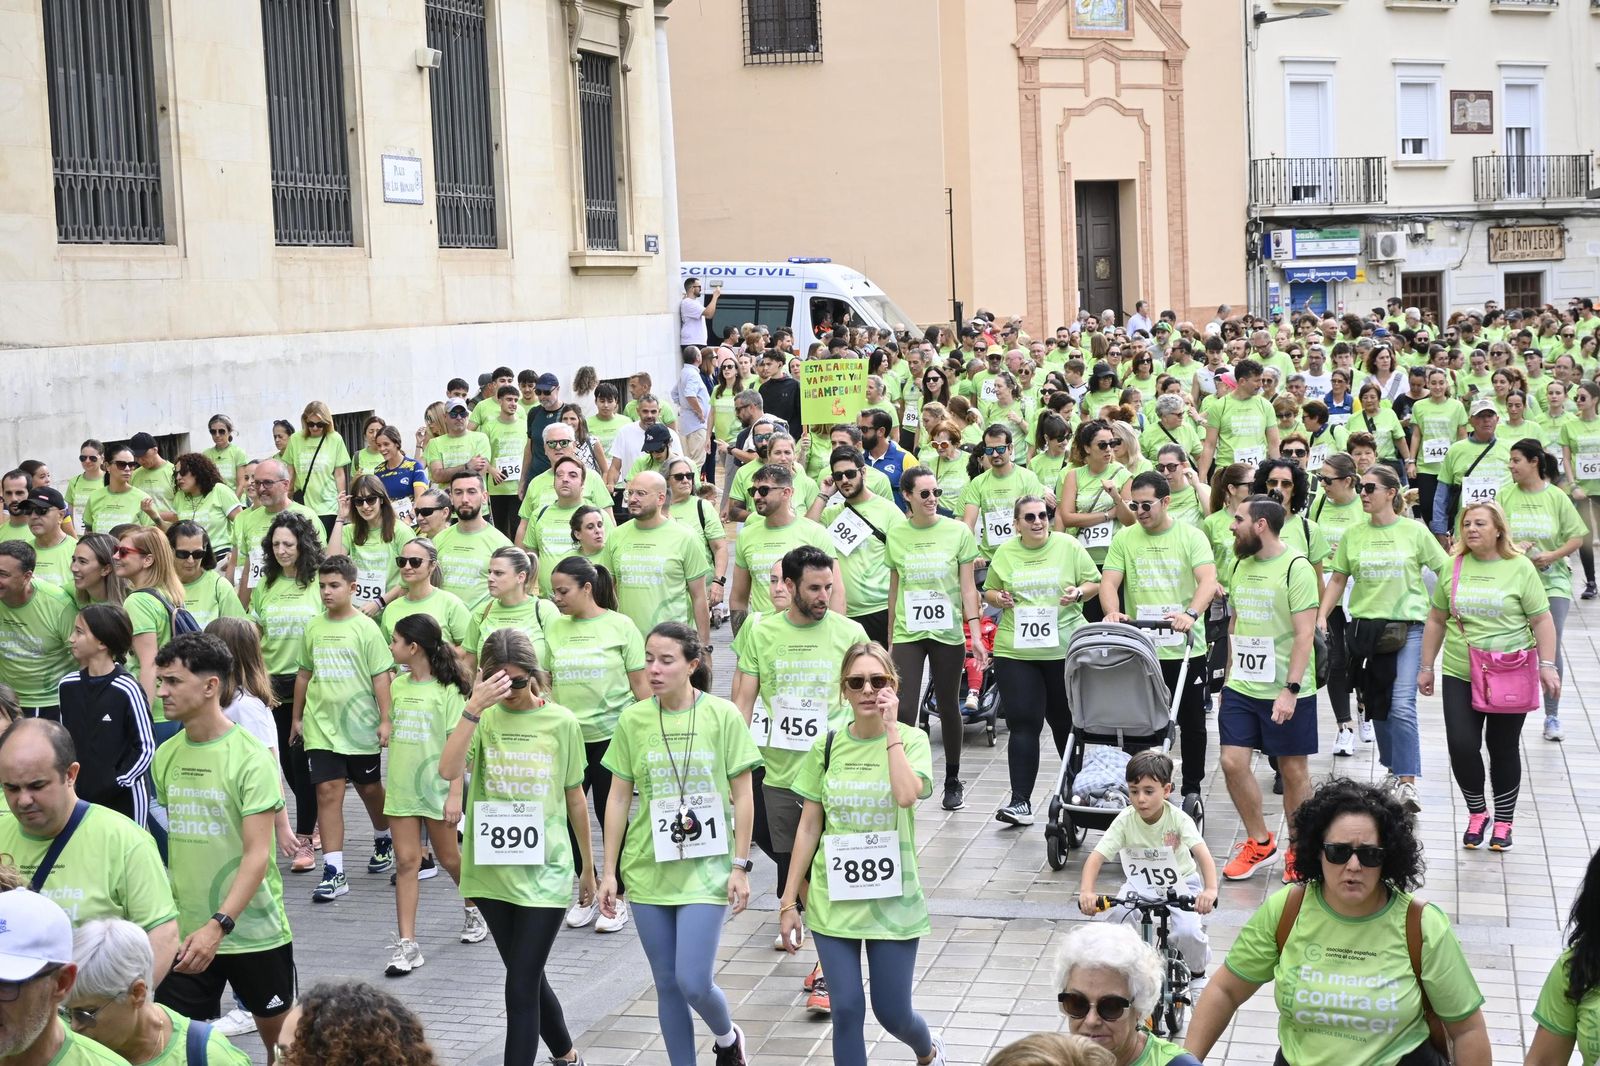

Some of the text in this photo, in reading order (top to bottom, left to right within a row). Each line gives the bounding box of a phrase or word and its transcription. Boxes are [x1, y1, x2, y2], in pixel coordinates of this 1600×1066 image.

[1498, 229, 1554, 251] LA TRAVIESA
[745, 268, 796, 277] CIVIL
[805, 364, 823, 373] ESTA
[806, 377, 818, 385] VA
[834, 522, 858, 545] 984
[912, 605, 945, 620] 708
[1020, 622, 1051, 637] 706
[775, 659, 832, 670] En marcha
[1237, 653, 1267, 670] 707
[556, 667, 608, 680] cáncer
[776, 671, 832, 683] contra el
[777, 681, 832, 698] cáncer
[780, 716, 818, 737] 456
[486, 747, 552, 763] En marcha
[648, 748, 714, 762] En marcha
[486, 764, 551, 780] contra el
[650, 765, 698, 778] conta
[168, 784, 226, 801] En marcha
[485, 776, 549, 796] cáncer
[652, 778, 715, 795] cáncer
[828, 778, 842, 791] En
[828, 794, 893, 808] contra el
[168, 801, 226, 819] contra el
[830, 806, 895, 827] cáncer
[168, 815, 229, 836] cáncer
[1300, 965, 1400, 989] En marcha
[1296, 988, 1399, 1011] contra el
[1295, 1007, 1399, 1034] cáncer
